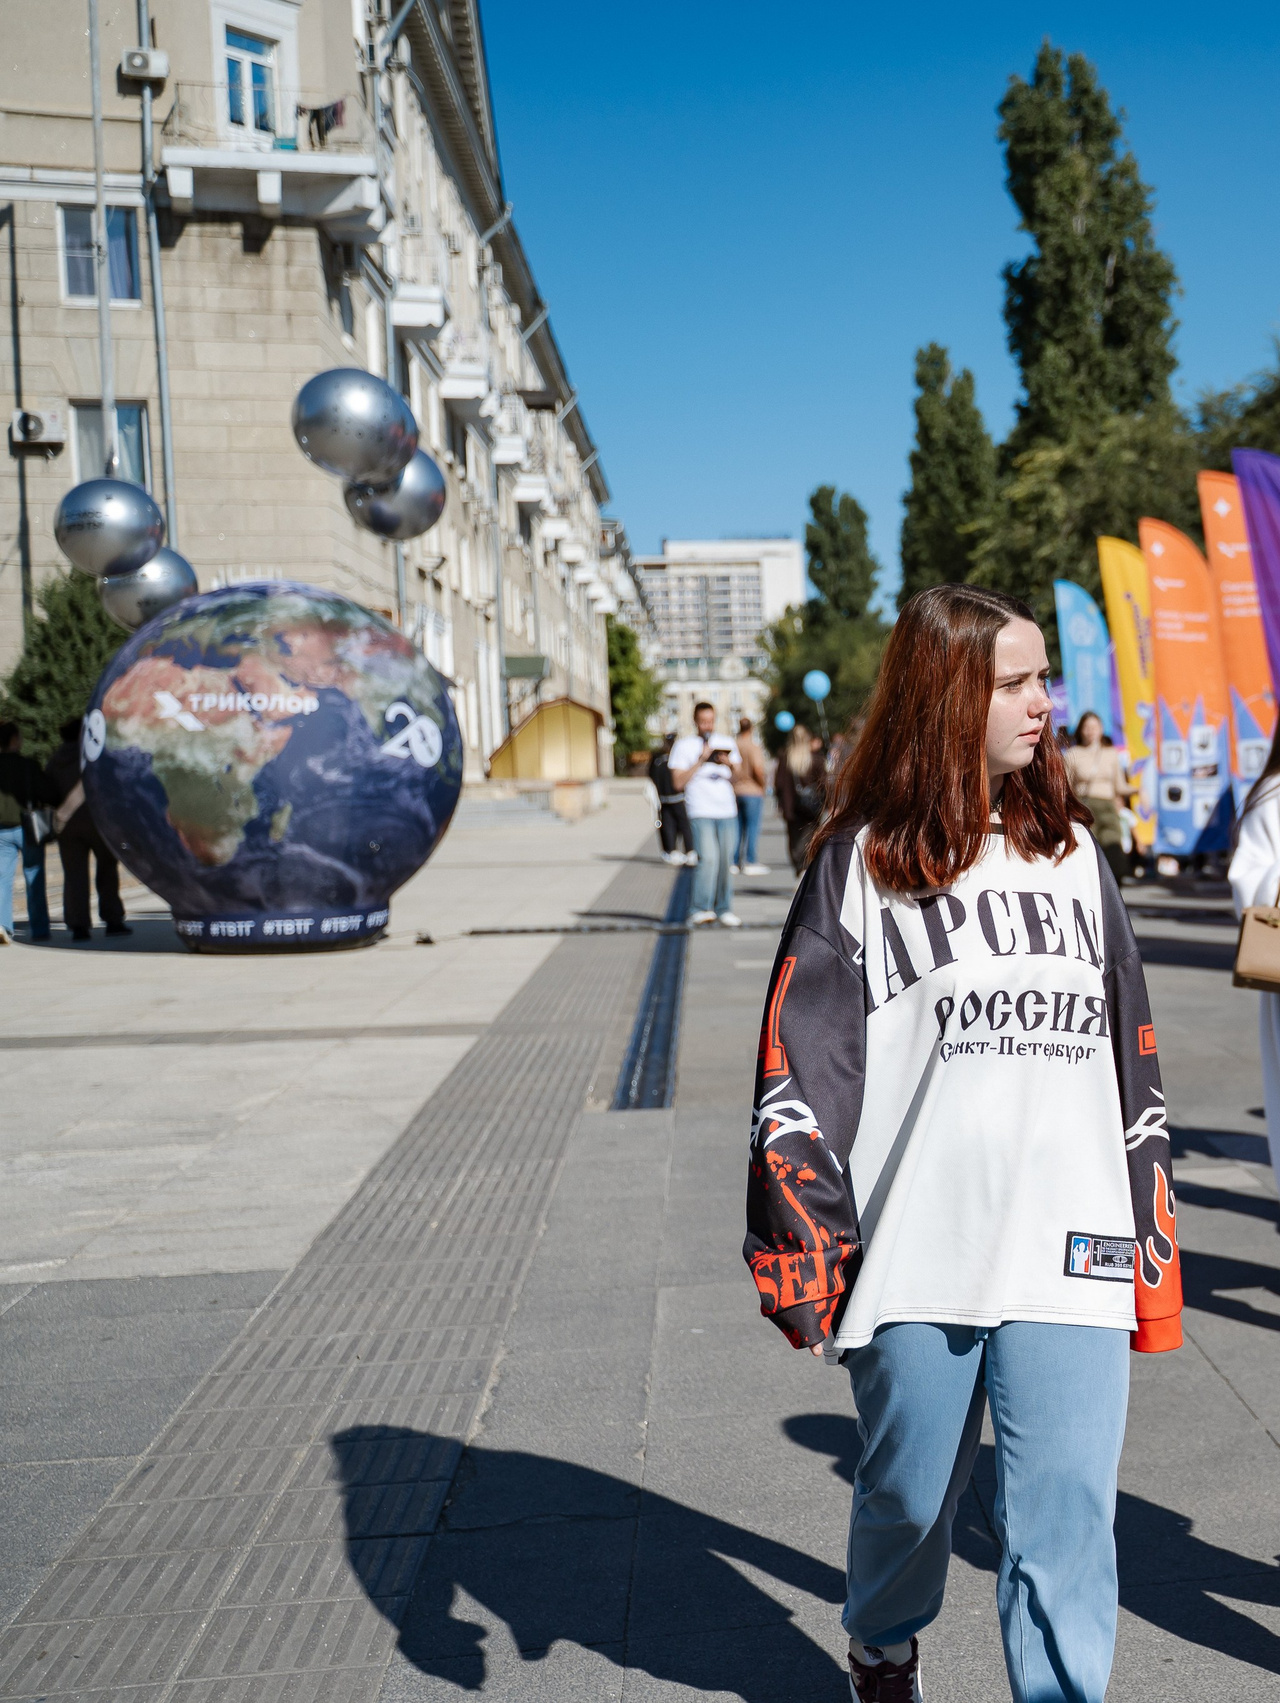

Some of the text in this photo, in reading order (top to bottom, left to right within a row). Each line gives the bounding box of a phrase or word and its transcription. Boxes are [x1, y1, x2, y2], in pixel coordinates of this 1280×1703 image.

[188, 692, 320, 715] ТРИКОЛОР
[379, 701, 443, 768] 20
[934, 990, 1110, 1041] РОССИЯ
